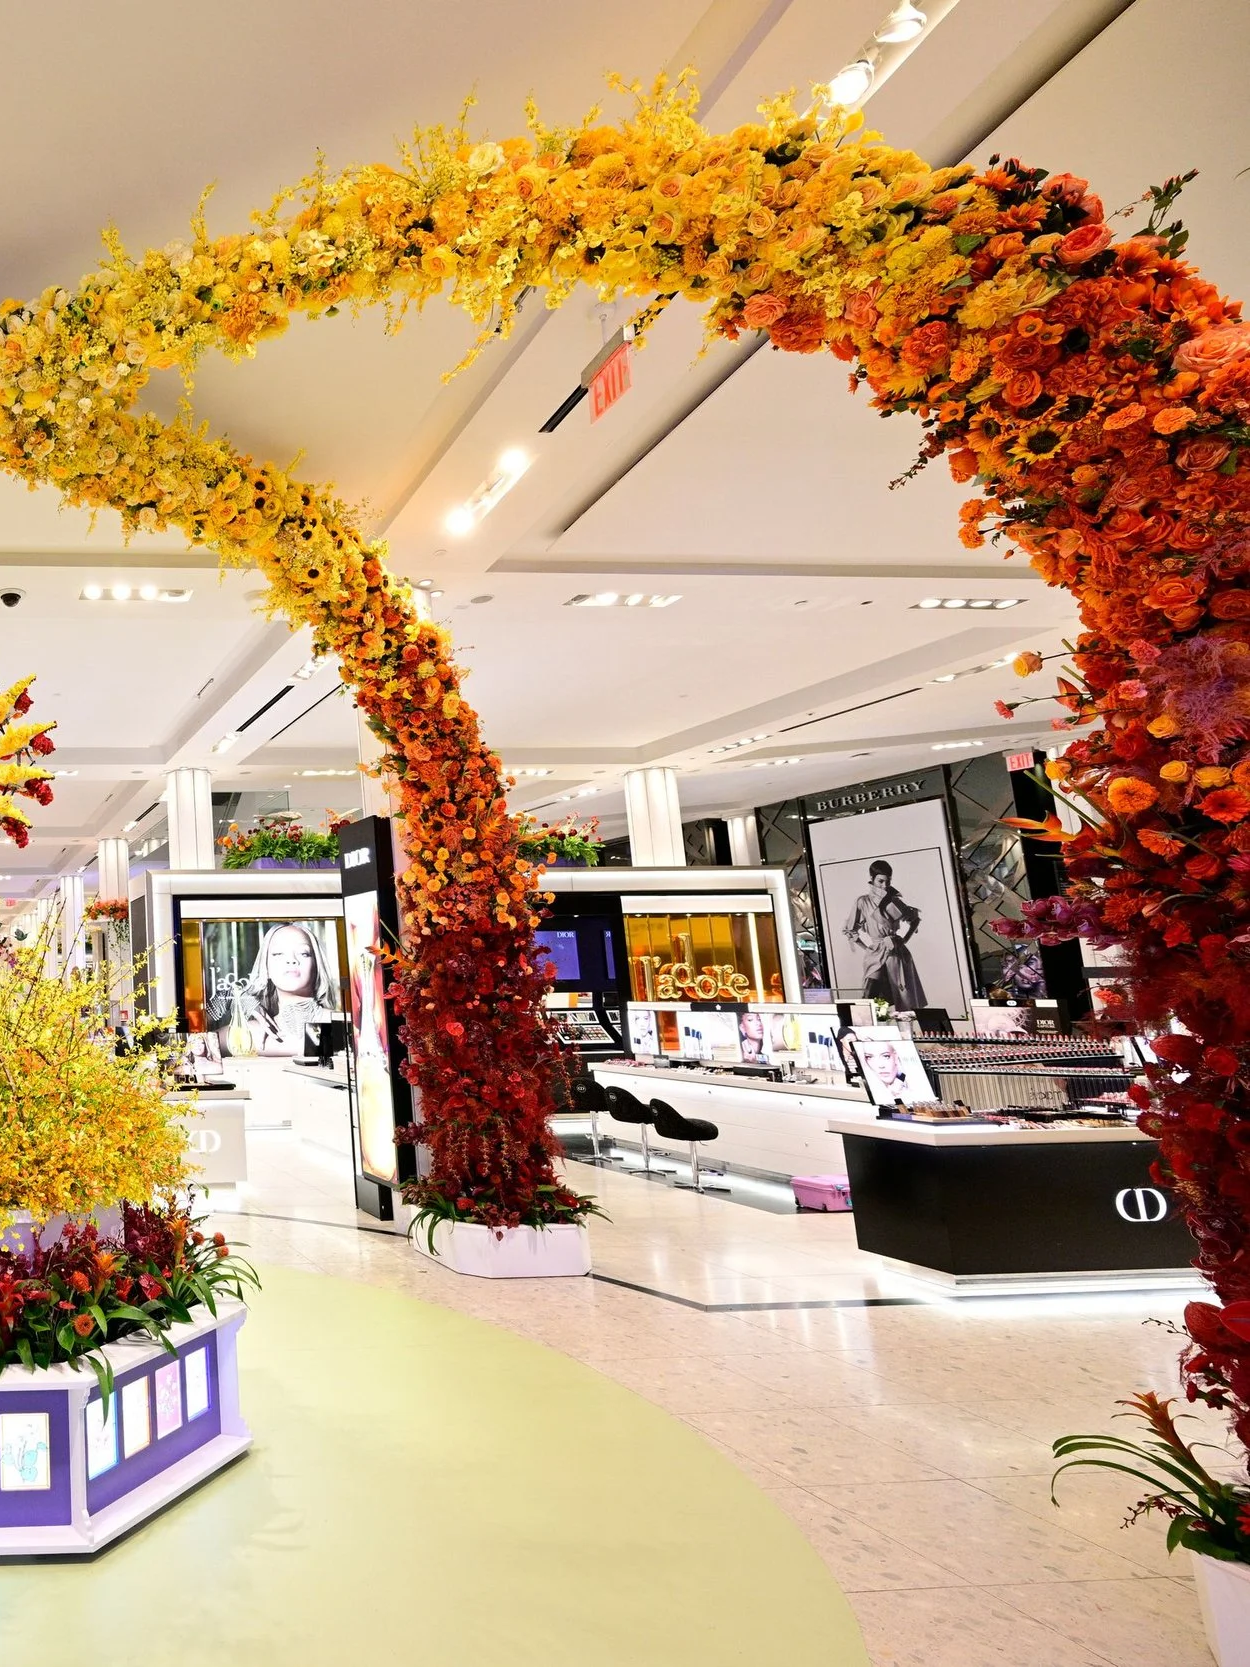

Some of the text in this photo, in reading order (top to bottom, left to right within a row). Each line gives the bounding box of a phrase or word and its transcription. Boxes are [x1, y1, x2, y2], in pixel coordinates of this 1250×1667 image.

[594, 358, 624, 417] EXIT
[1009, 754, 1031, 769] EXIT
[816, 780, 926, 811] BURBERRY
[344, 847, 370, 869] DIOR
